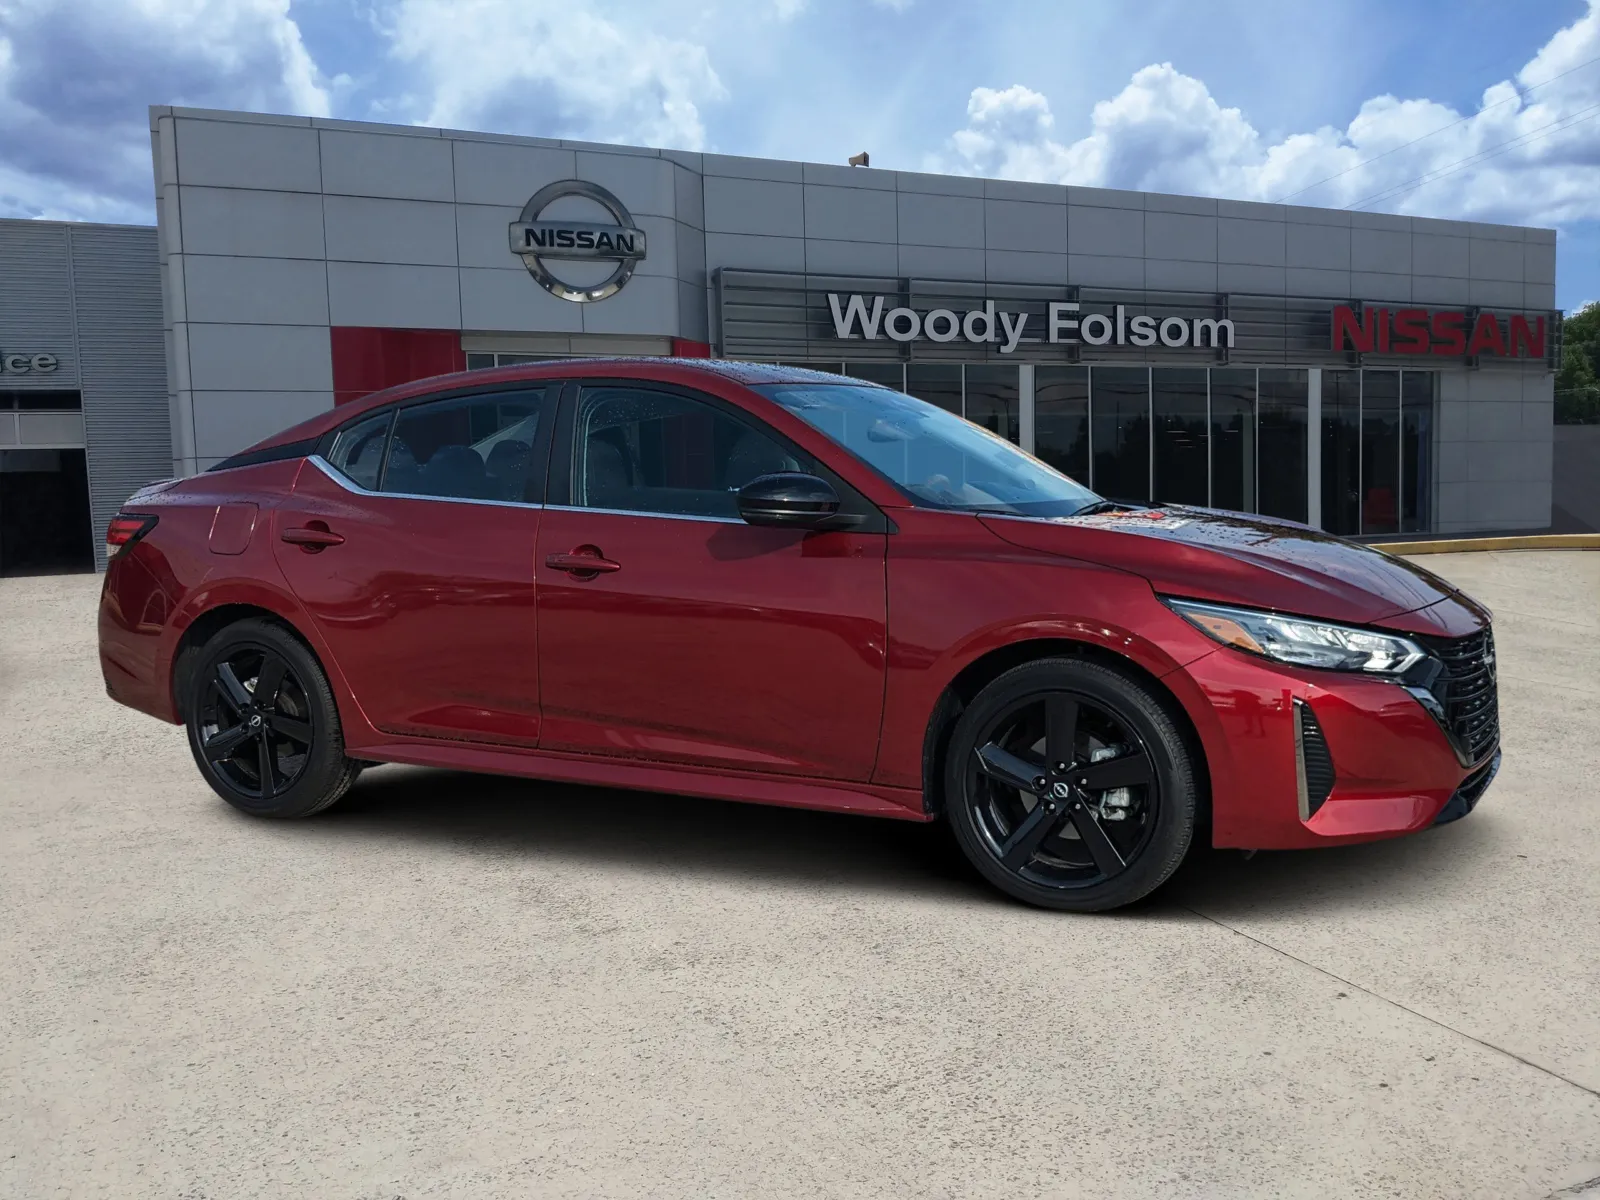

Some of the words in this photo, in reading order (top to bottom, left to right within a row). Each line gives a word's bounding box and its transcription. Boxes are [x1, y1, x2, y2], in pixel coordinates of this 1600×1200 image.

[525, 228, 634, 252] NISSAN
[828, 293, 1028, 353] Woody
[1048, 301, 1235, 348] Folsom
[1331, 304, 1545, 359] NISSAN
[0, 352, 57, 374] ce
